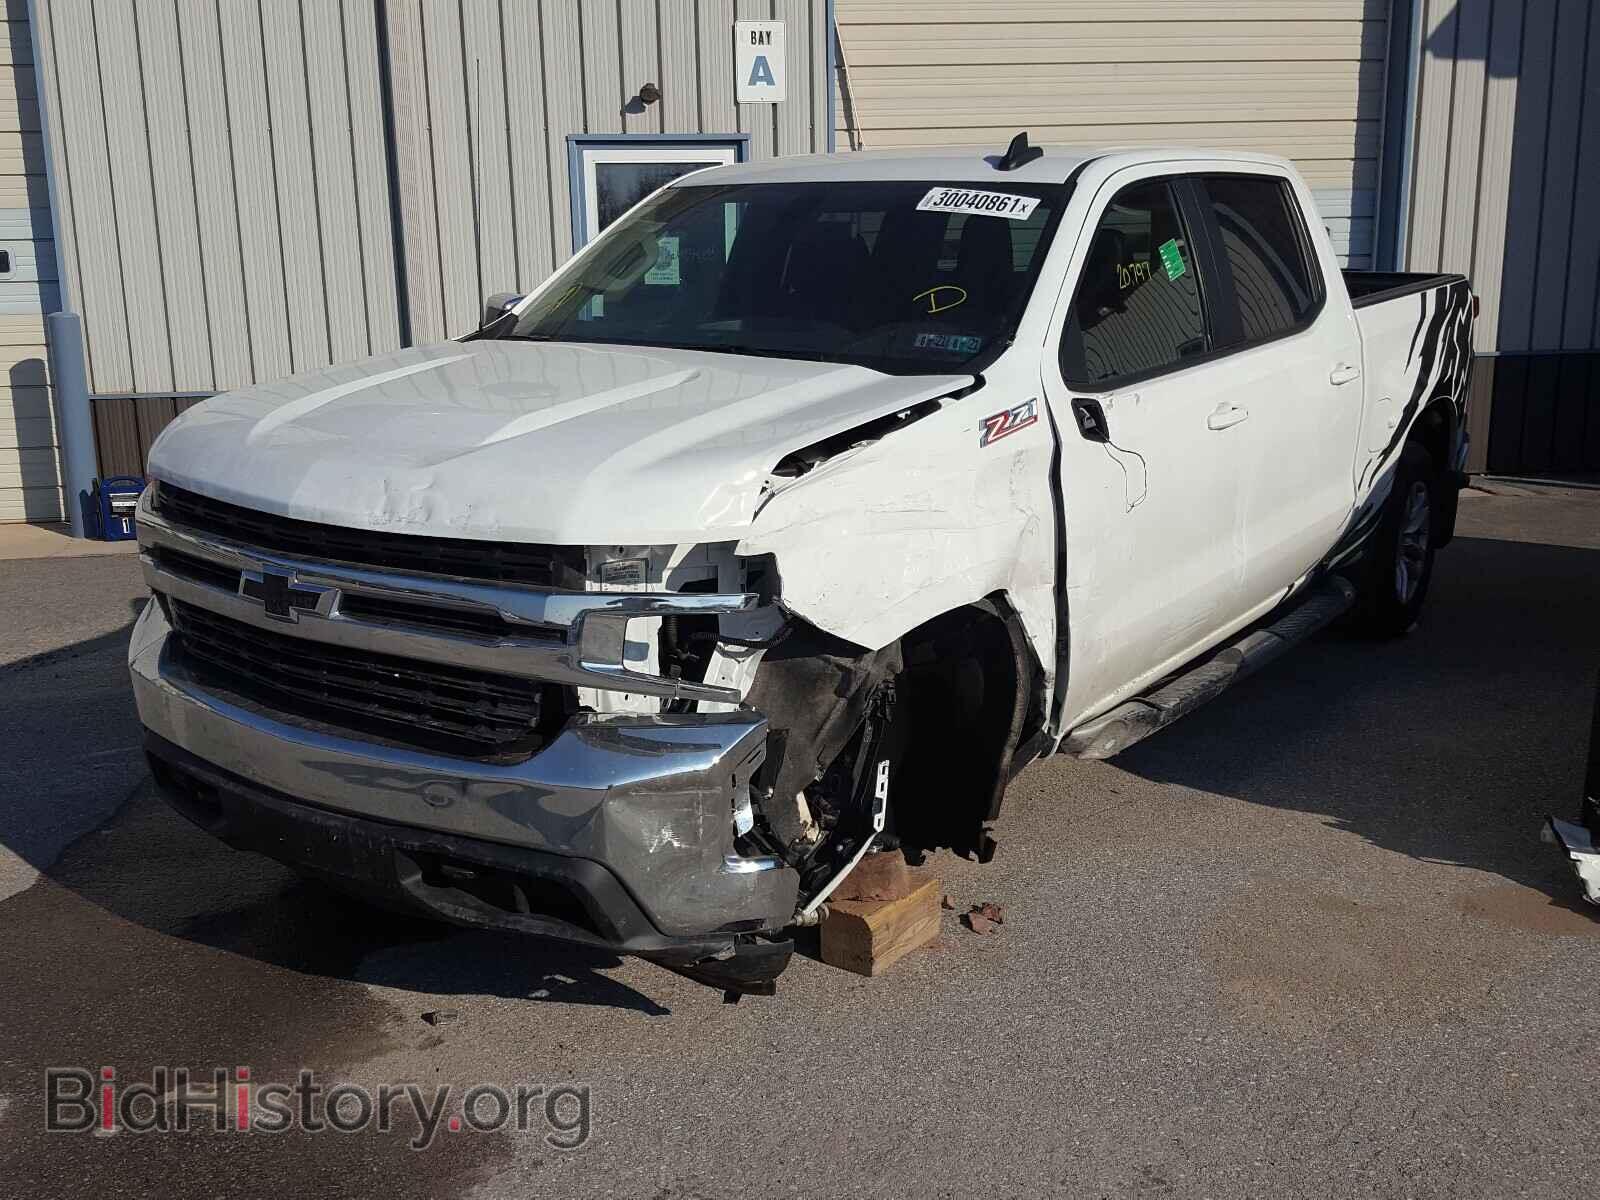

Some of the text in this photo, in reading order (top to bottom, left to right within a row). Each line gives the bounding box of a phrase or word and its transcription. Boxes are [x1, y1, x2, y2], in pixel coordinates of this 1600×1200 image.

[750, 30, 772, 46] BAY
[748, 55, 776, 86] A
[933, 191, 1021, 213] 30040861
[912, 285, 968, 314] D
[979, 397, 1038, 448] Z71
